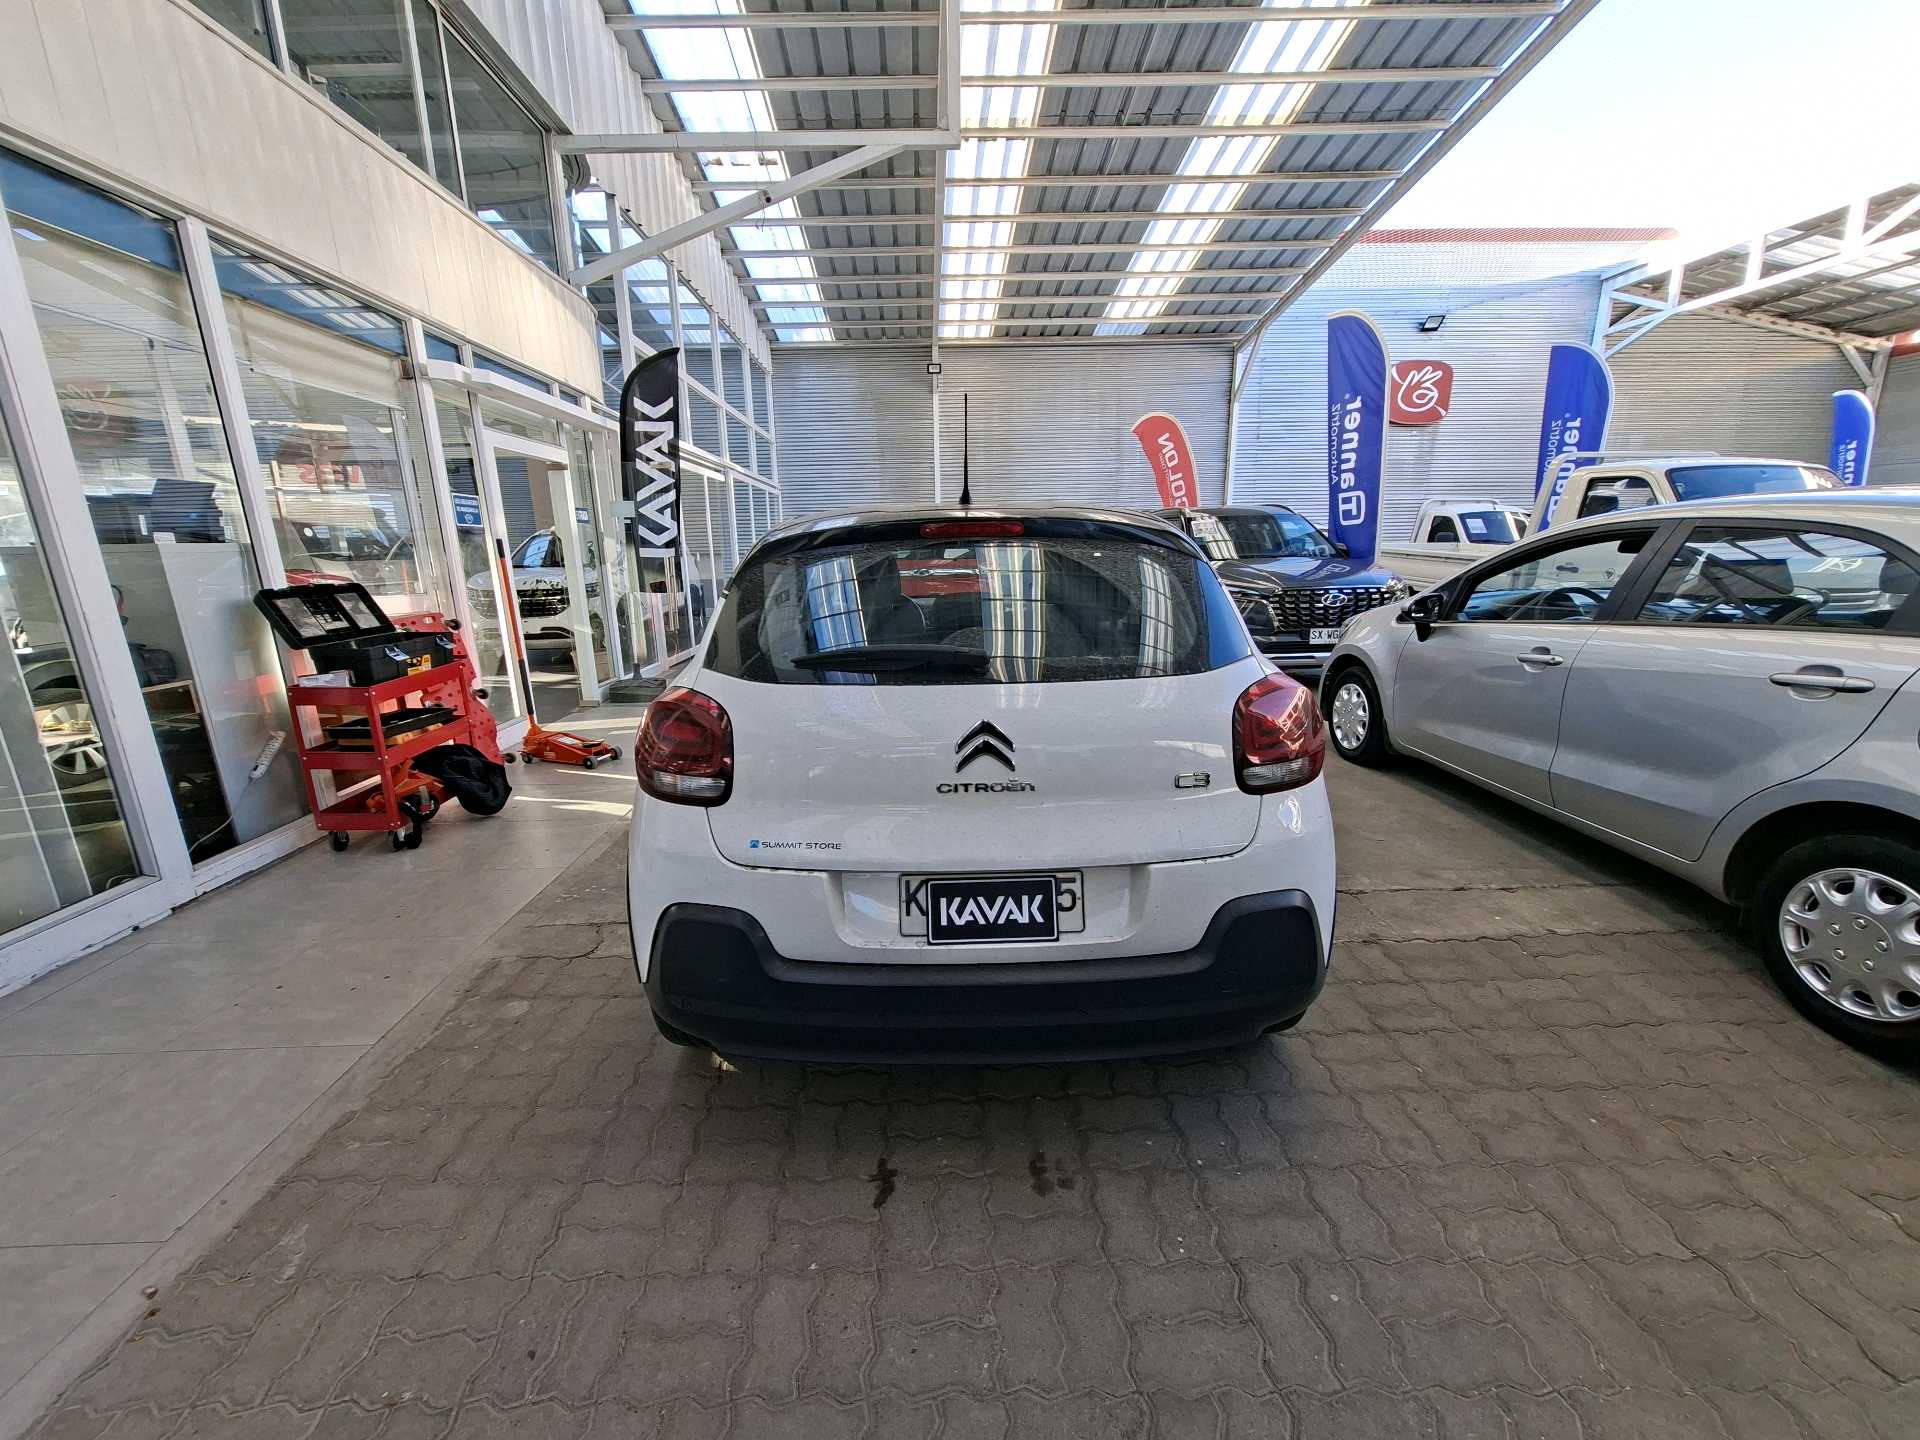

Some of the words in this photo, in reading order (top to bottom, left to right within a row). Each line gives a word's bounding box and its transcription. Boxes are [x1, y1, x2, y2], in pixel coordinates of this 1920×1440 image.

[634, 396, 678, 558] KAVAK
[1174, 772, 1211, 788] C3
[761, 841, 802, 849] SUMMIT
[805, 842, 842, 850] STORE
[940, 894, 1045, 926] KAVAK
